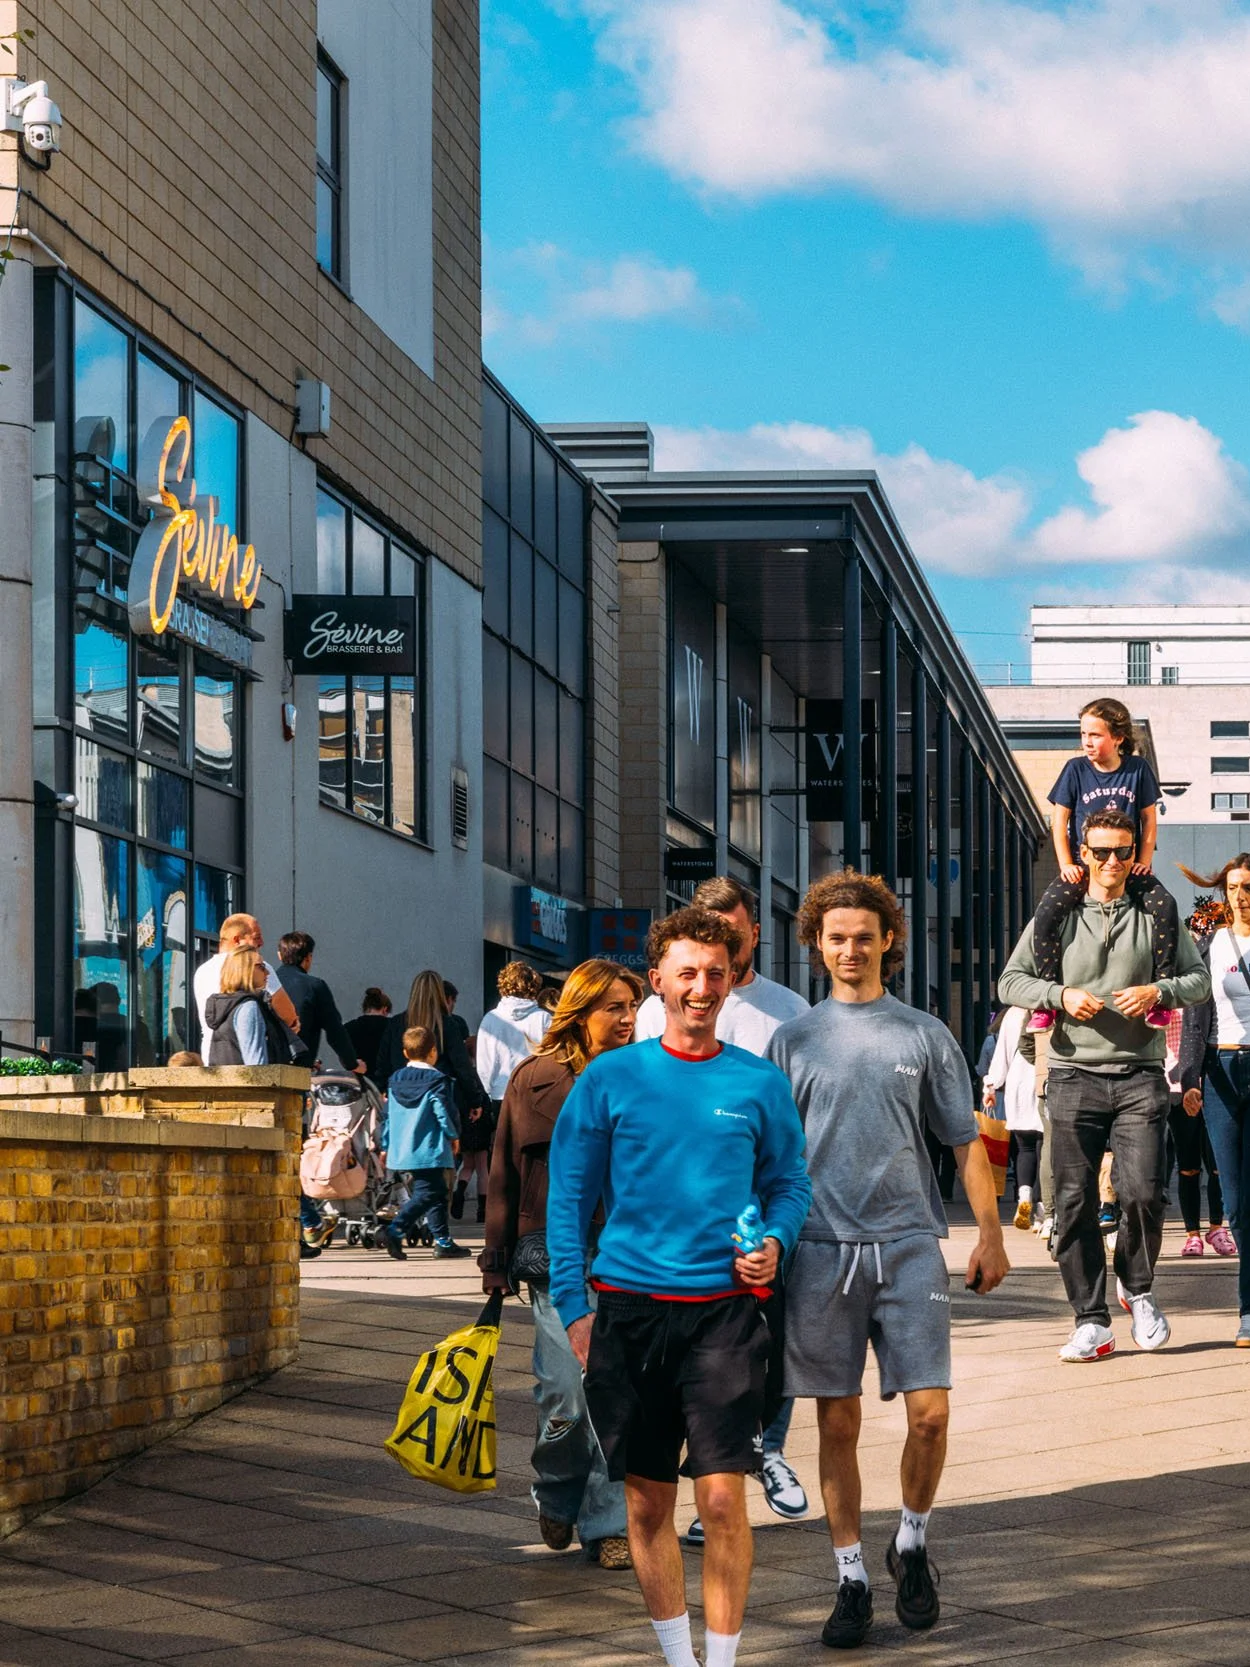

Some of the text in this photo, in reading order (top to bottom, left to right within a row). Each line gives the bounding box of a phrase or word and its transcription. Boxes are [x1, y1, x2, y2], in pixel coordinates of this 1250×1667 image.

[303, 611, 404, 659] Sévine
[326, 645, 403, 654] BRASSERIE & BAR
